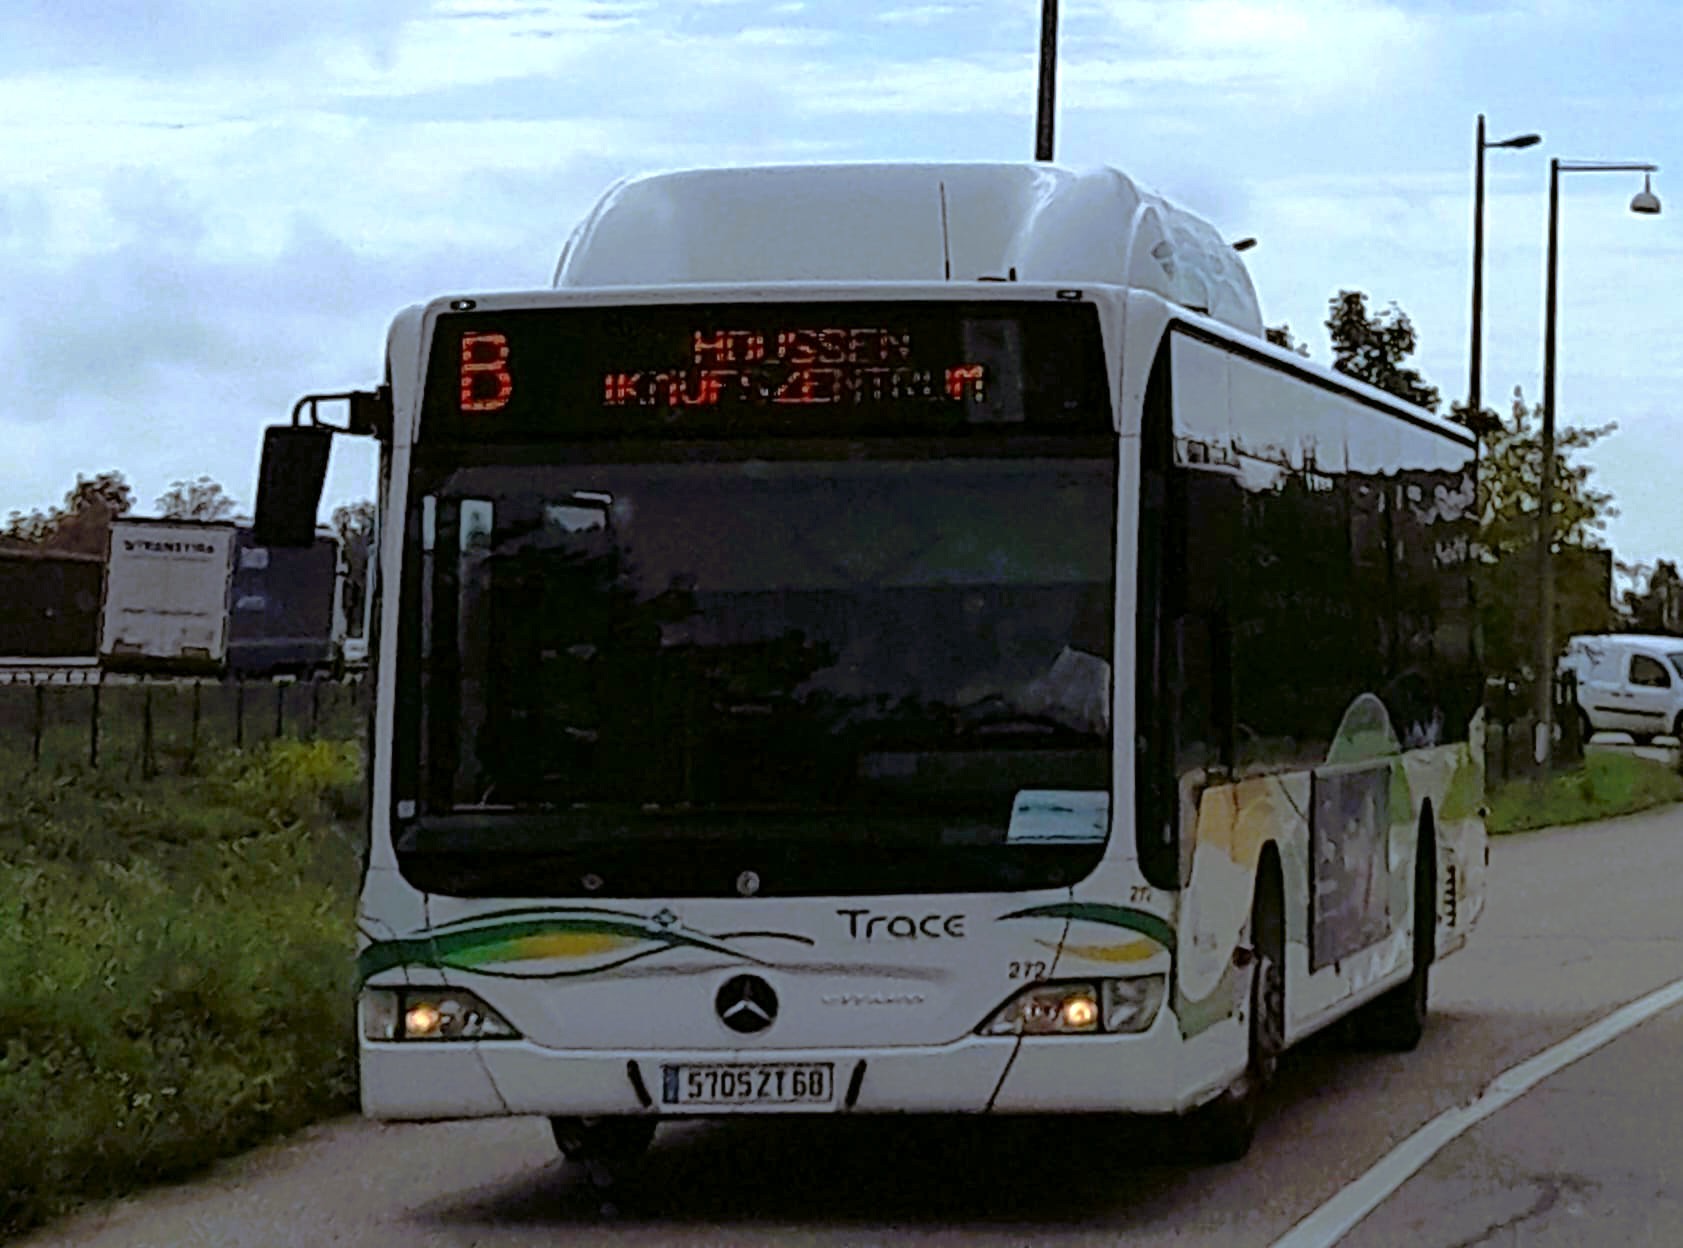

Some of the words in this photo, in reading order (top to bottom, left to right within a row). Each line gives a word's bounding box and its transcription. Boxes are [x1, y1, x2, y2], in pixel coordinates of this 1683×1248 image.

[694, 330, 910, 364] HOUSSEN
[461, 331, 512, 410] B
[836, 909, 966, 940] Trace
